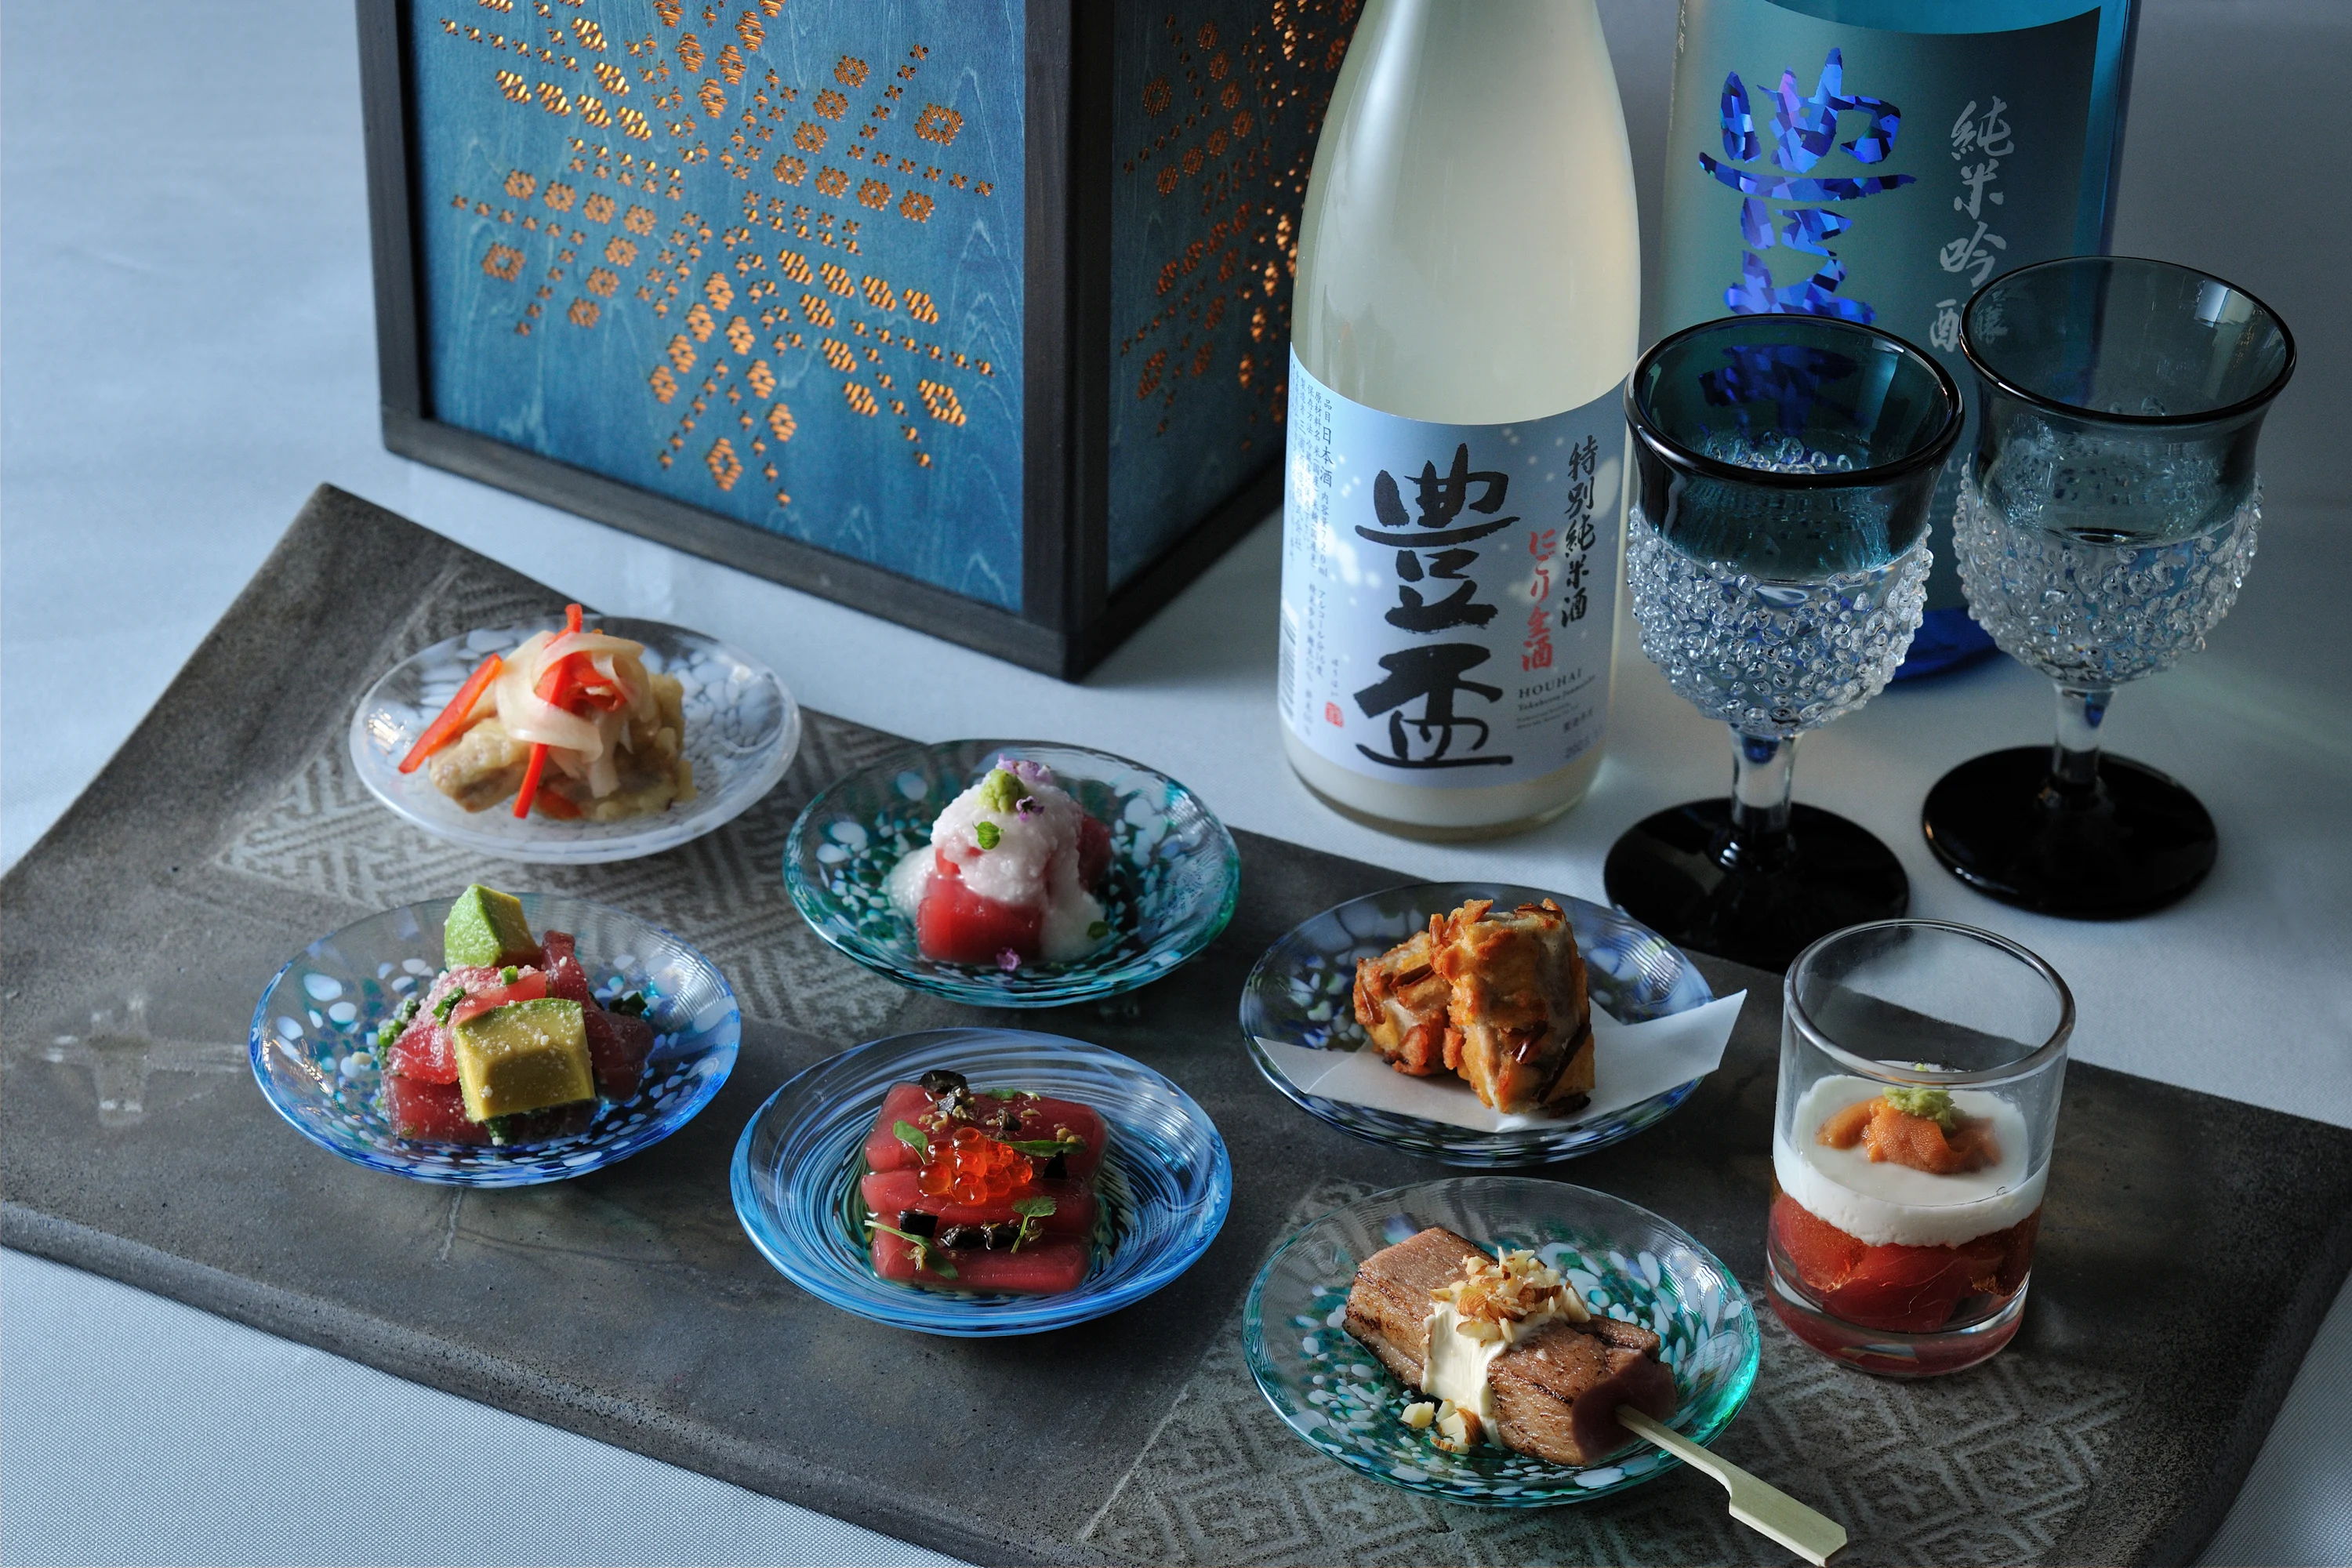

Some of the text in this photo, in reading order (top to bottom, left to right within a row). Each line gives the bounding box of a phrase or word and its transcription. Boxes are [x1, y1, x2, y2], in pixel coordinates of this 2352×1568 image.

[1313, 391, 1323, 441] 原材料名
[1320, 399, 1334, 488] 品目 日本酒
[1560, 434, 1599, 628] 特別純米酒
[1353, 442, 1520, 768] 豊盃
[1522, 528, 1556, 672] にごり生酒
[1519, 668, 1582, 699] HOUHAI
